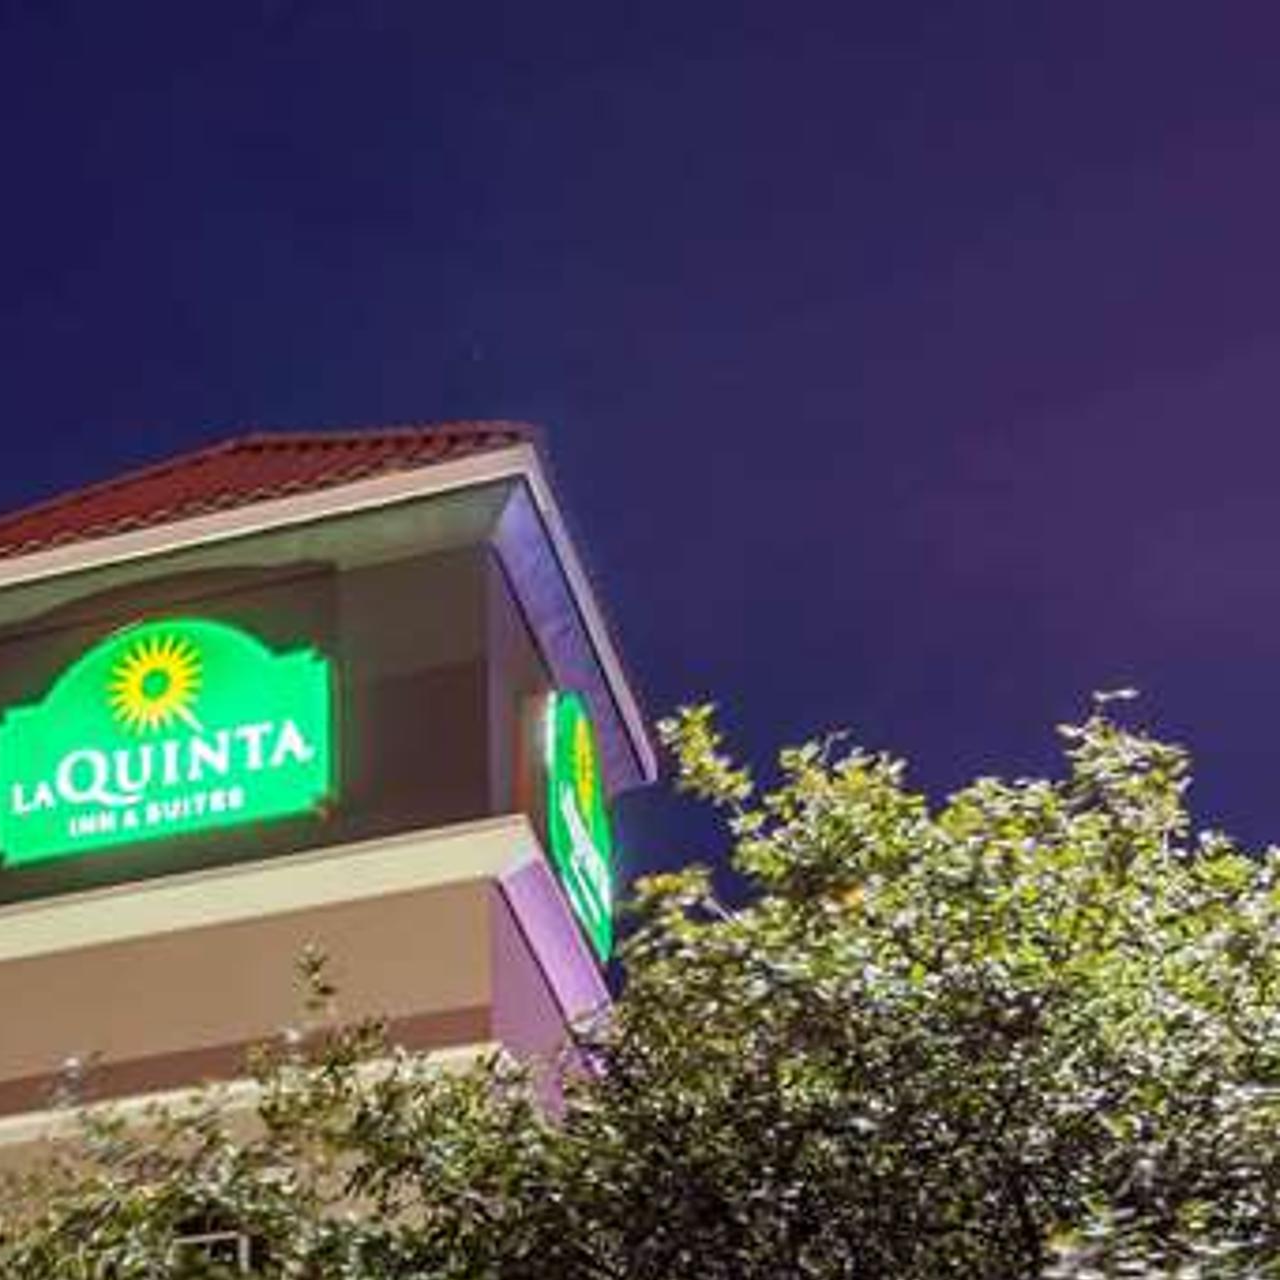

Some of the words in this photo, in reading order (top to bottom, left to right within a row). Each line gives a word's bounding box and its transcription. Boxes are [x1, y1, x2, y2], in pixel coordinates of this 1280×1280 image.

[11, 781, 56, 815] LA
[57, 719, 315, 807] QUINTA
[69, 809, 117, 836] INN
[122, 808, 139, 829] &
[146, 784, 244, 825] SUITES
